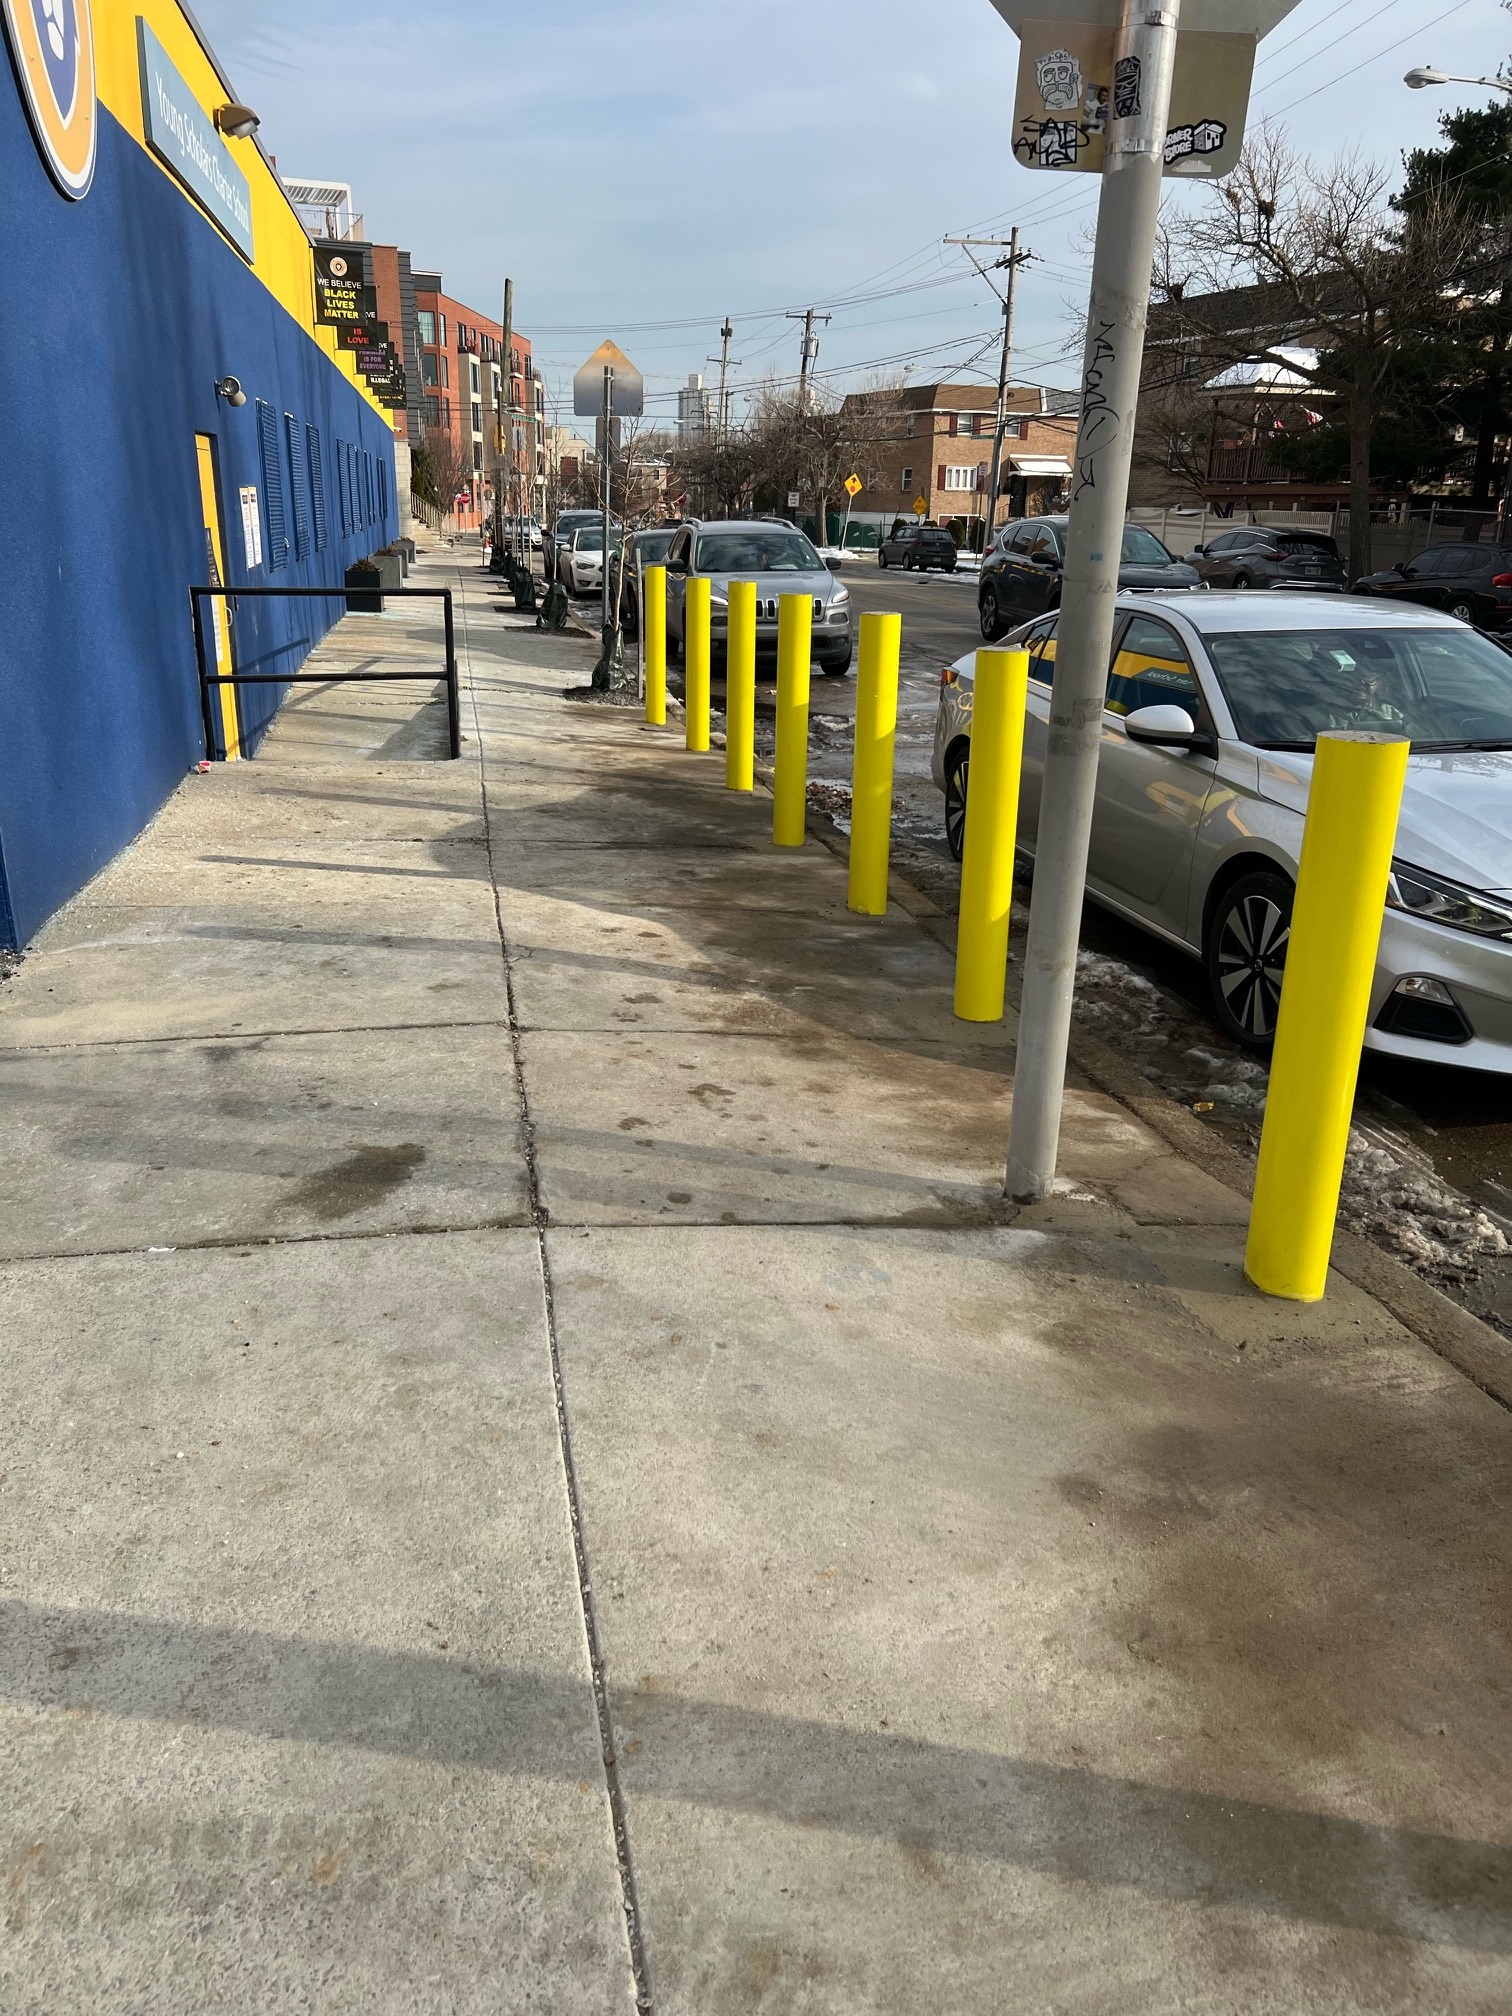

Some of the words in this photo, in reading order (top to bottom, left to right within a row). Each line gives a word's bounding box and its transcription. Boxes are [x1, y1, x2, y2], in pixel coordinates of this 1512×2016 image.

[154, 71, 186, 157] Young
[184, 112, 213, 184] Scholars
[212, 155, 233, 211] Charter
[232, 184, 250, 234] School
[317, 278, 329, 286] WE
[331, 279, 362, 289] BELIEVE
[324, 288, 356, 299] BLACK
[326, 299, 355, 309] LIVES
[324, 309, 359, 319] MATTER
